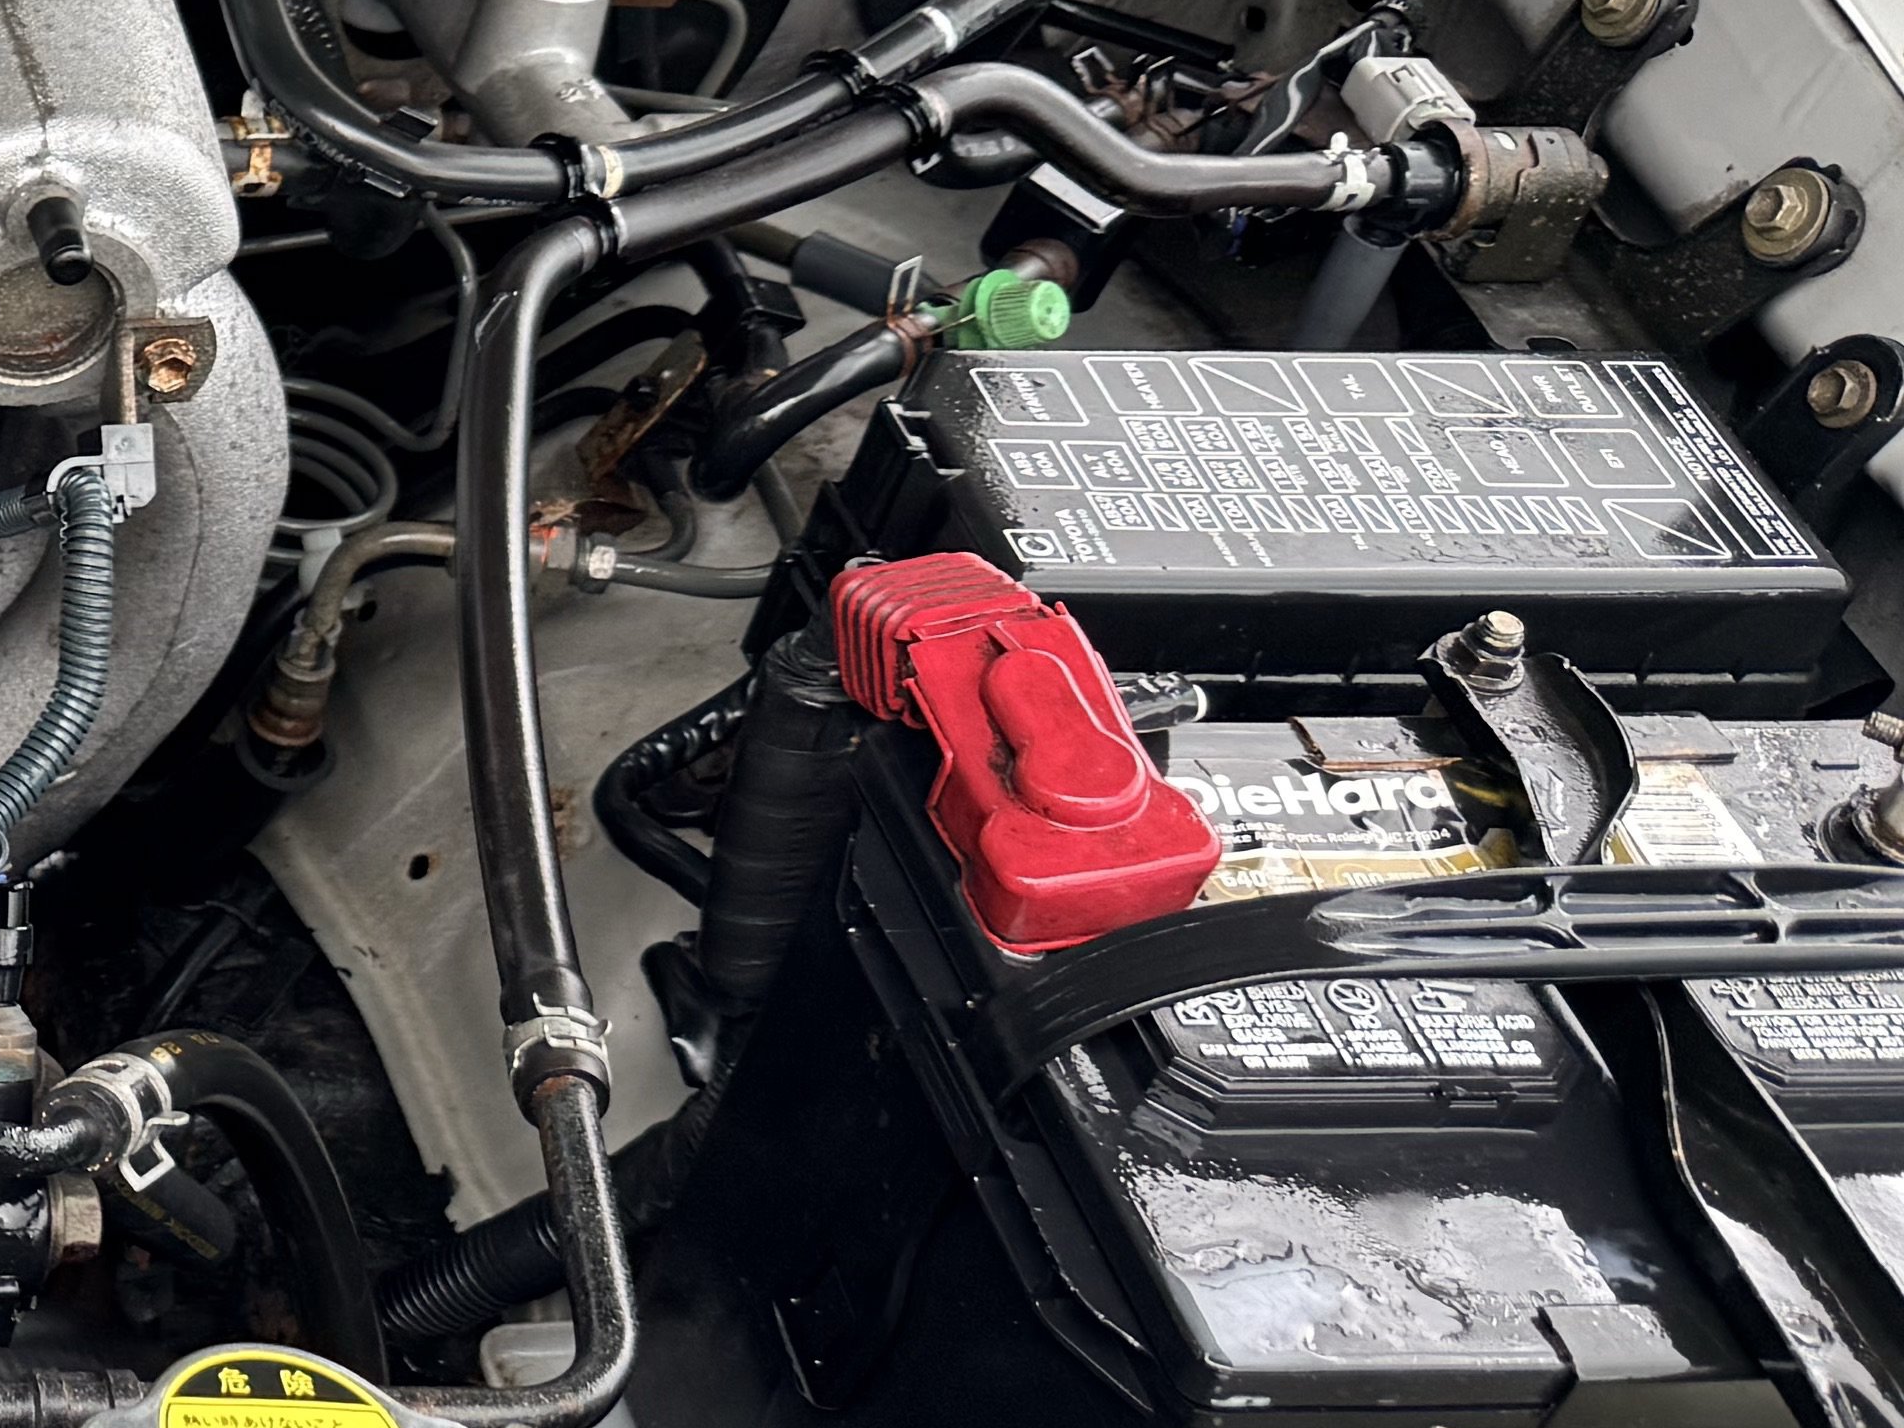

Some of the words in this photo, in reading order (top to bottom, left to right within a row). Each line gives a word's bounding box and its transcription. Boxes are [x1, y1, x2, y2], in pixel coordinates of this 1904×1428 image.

[1007, 372, 1051, 420] STARTER
[1120, 362, 1164, 408] HEATER
[1336, 374, 1369, 398] TAIL
[1529, 375, 1565, 402] PWR
[1550, 366, 1602, 412] OUTLET
[1008, 451, 1037, 475] ABS
[1081, 453, 1111, 477] ALT
[1487, 440, 1526, 473] HEAD
[1596, 448, 1627, 468] EFI
[1664, 436, 1713, 479] NOTICE
[1416, 461, 1451, 486] 20A
[1183, 499, 1213, 523] 10A
[1219, 500, 1249, 523] 10A
[1323, 501, 1355, 524] 10A
[1393, 501, 1425, 525] 10A
[1051, 508, 1100, 562] TOYOTA
[1164, 769, 1454, 817] DieHard
[1769, 983, 1803, 998] WITH
[1777, 995, 1836, 1009] MEDICAL
[1836, 995, 1868, 1008] HELP
[1251, 1000, 1298, 1014] EYES
[1222, 1013, 1313, 1029] EXPLOSIVE
[1350, 1015, 1382, 1029] NO
[1495, 1015, 1536, 1029] ACID
[218, 1367, 317, 1399] 危険
